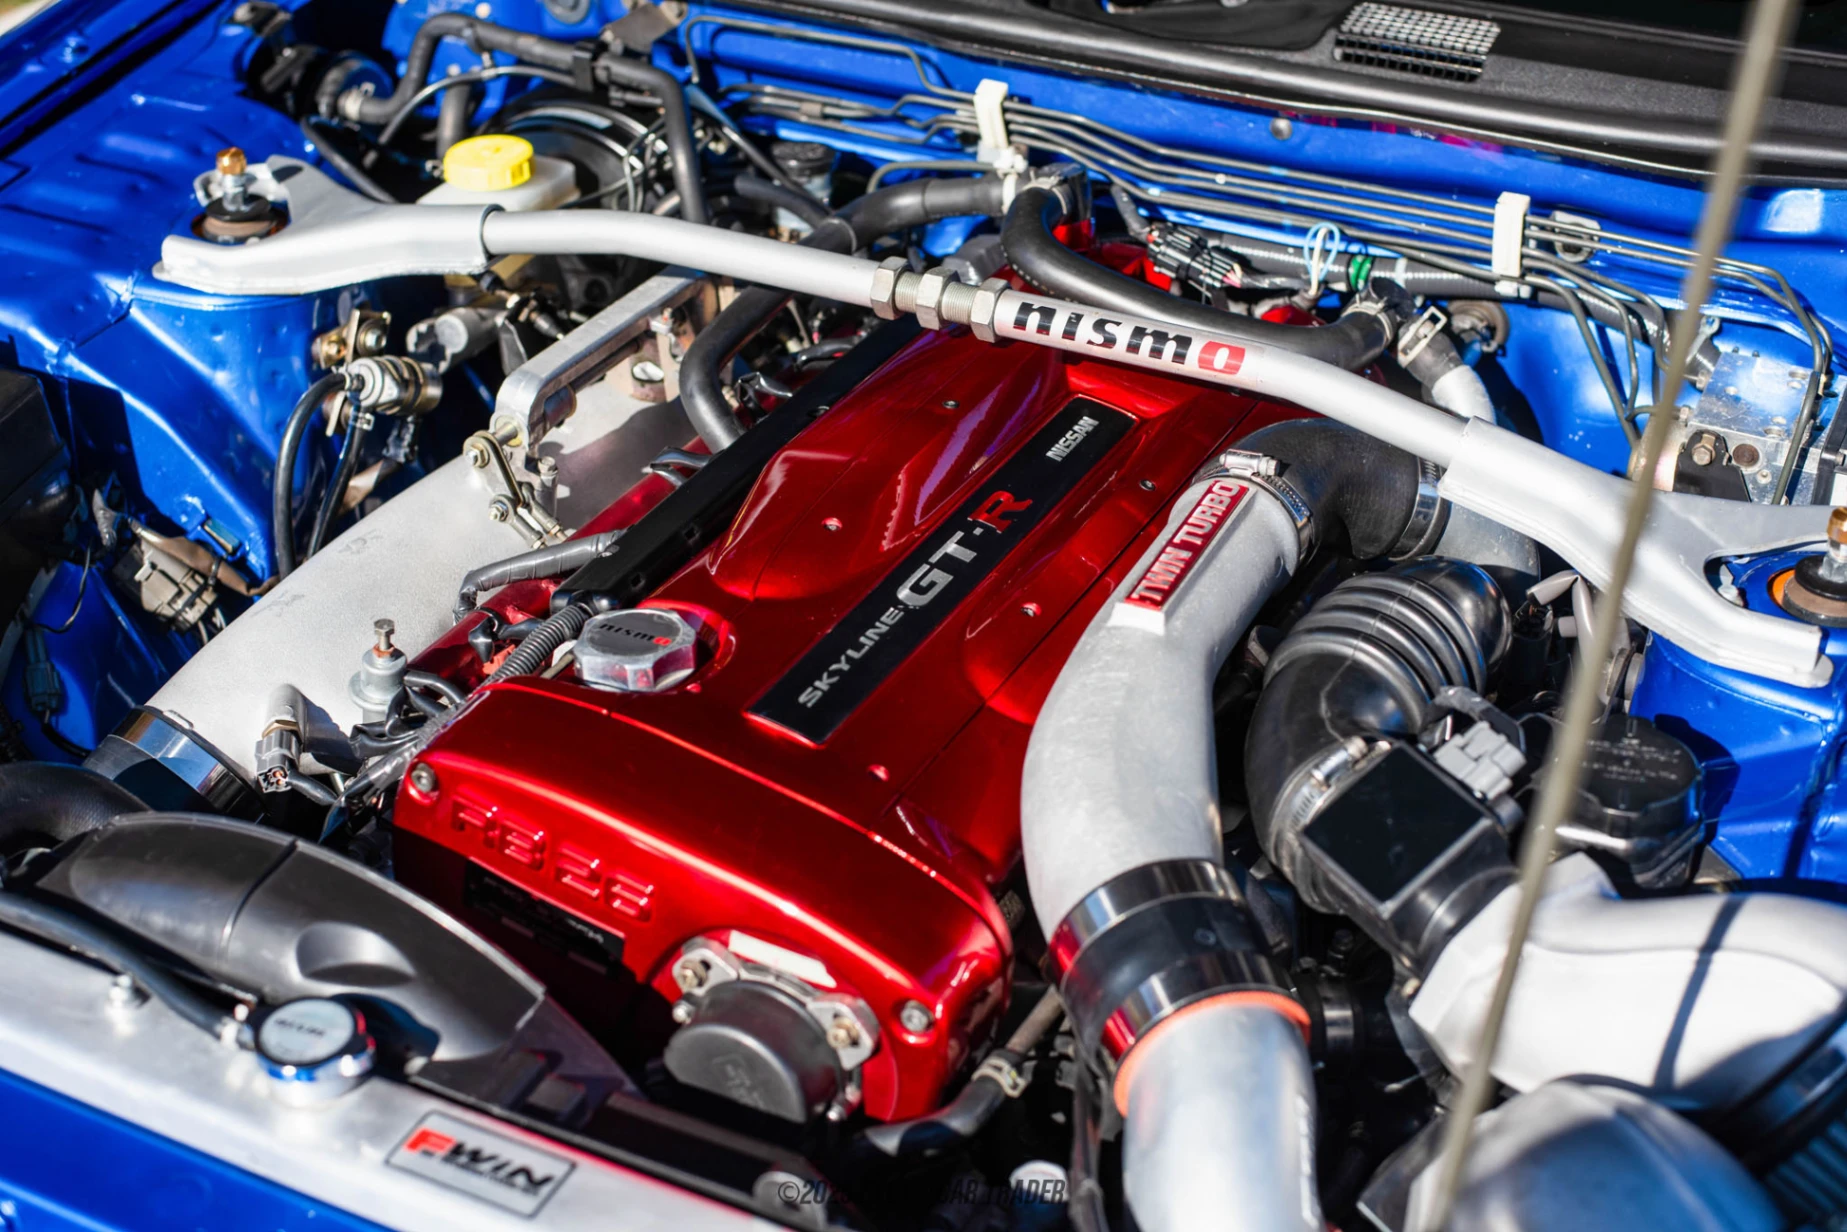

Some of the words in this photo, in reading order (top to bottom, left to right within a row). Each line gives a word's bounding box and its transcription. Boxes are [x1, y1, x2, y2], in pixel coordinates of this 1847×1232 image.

[1012, 300, 1246, 376] nismo
[1045, 415, 1100, 462] NISSAN
[1130, 546, 1193, 602] TWIN
[1172, 481, 1241, 545] TURBO
[797, 606, 905, 708] SKYLINE
